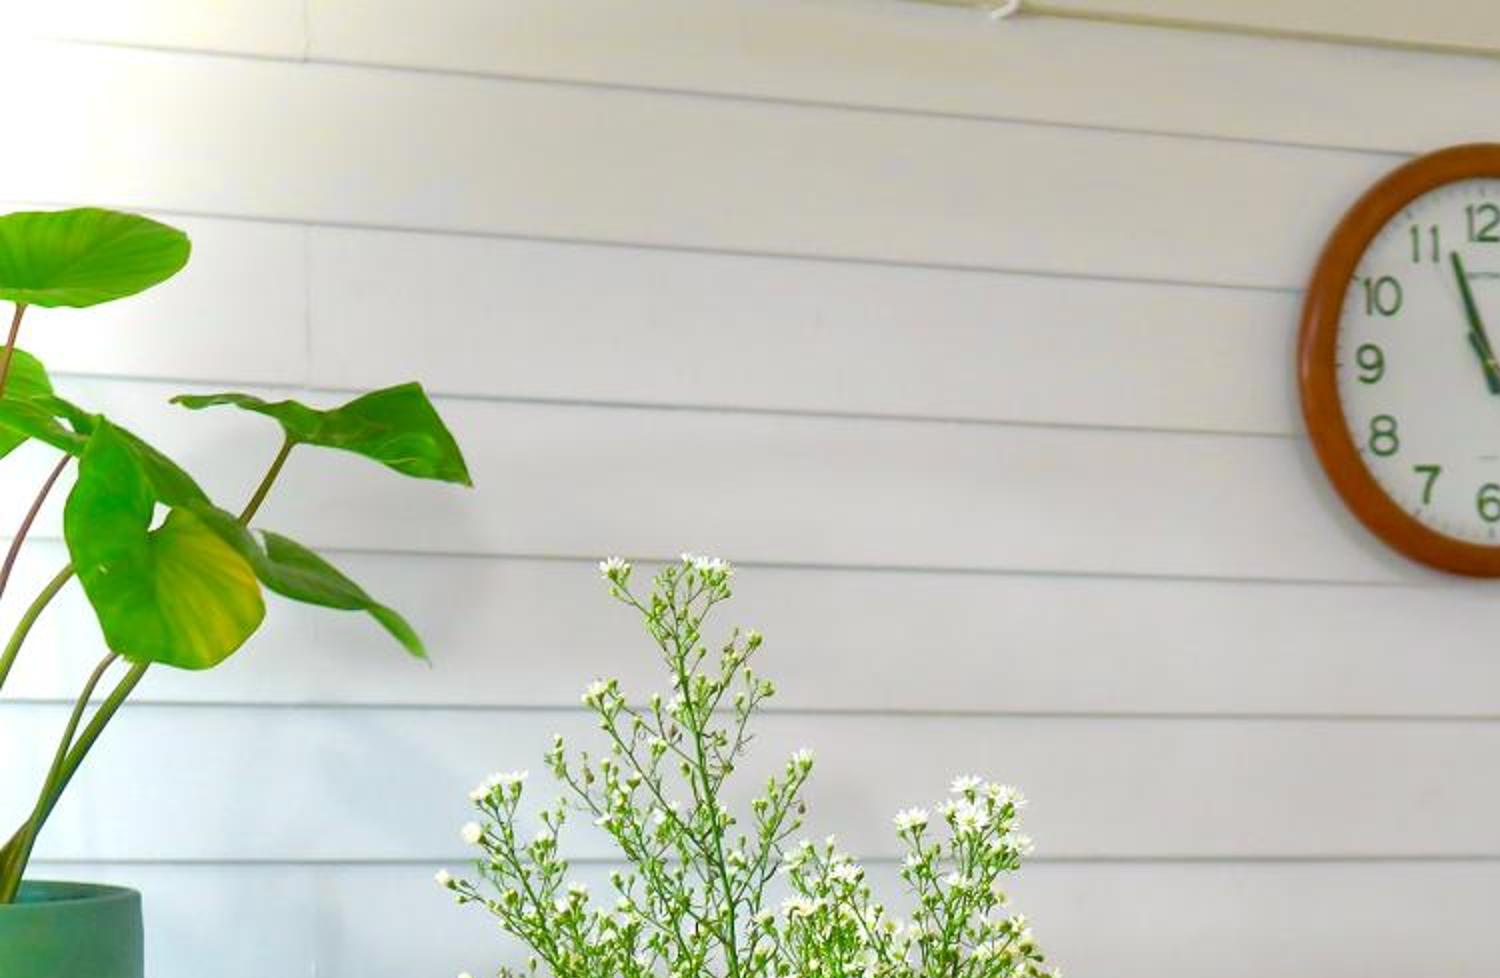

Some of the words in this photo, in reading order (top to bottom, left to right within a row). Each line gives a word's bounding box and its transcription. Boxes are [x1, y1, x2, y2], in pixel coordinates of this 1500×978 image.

[1410, 224, 1441, 264] 11
[1363, 275, 1403, 316] 10
[1355, 343, 1385, 384] 9
[1368, 414, 1400, 457] 8
[1413, 464, 1442, 505] 7
